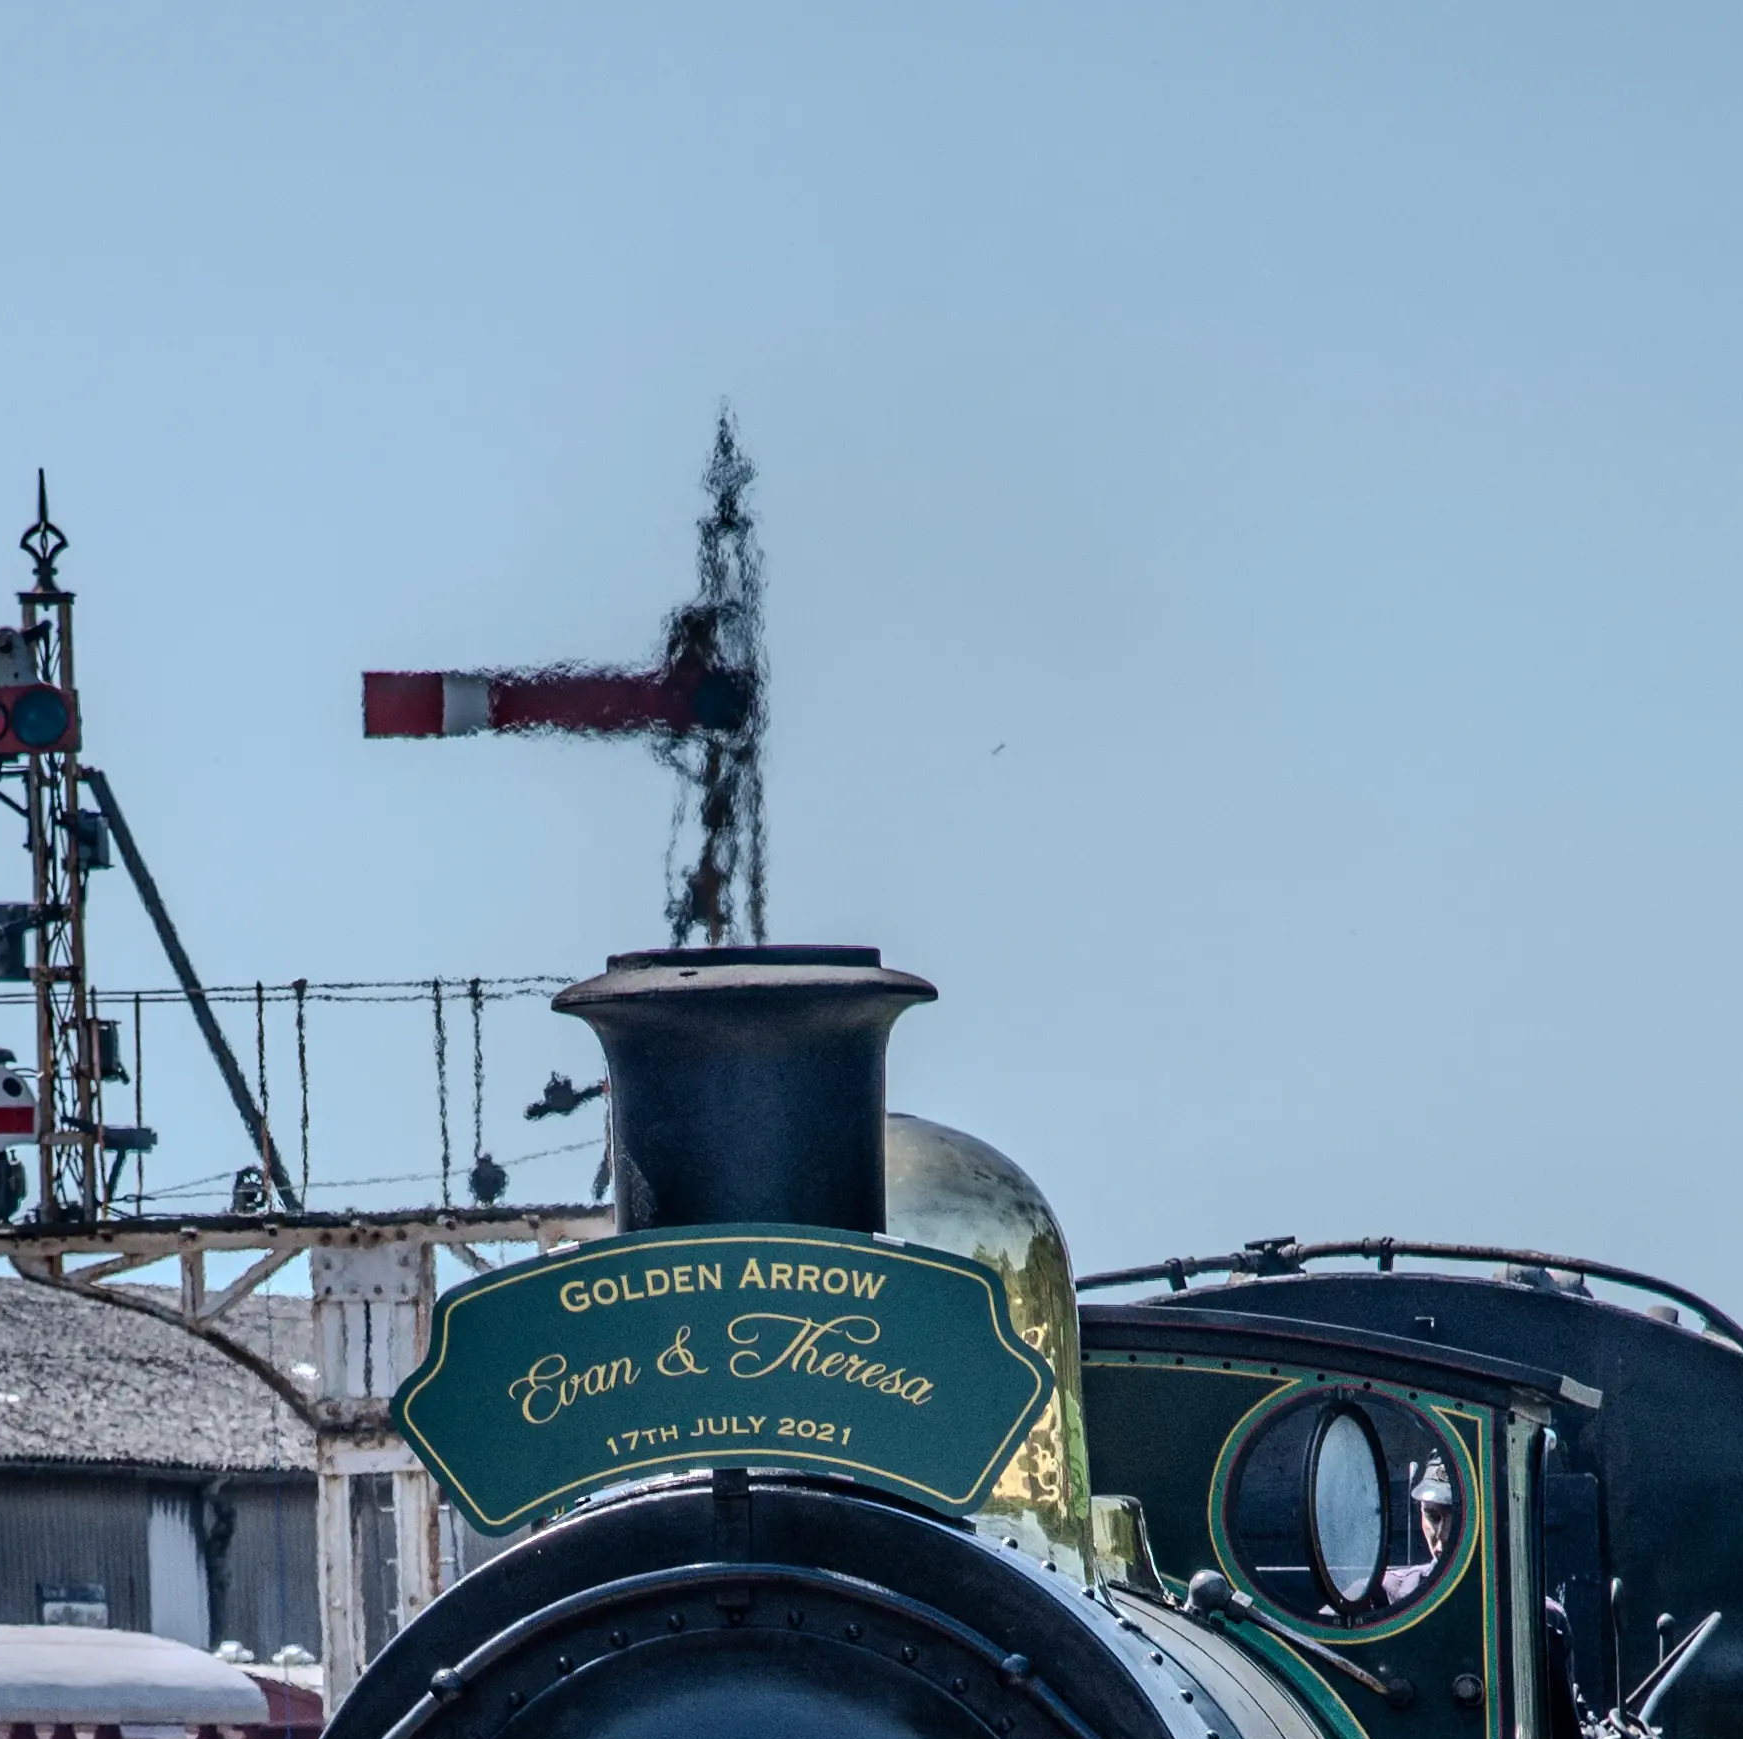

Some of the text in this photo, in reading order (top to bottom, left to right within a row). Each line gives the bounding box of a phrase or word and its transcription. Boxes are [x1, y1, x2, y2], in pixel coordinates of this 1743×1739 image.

[559, 1257, 887, 1313] GOLDEN ARROW
[508, 1312, 938, 1425] Evan & Theresa
[606, 1415, 853, 1456] 17TH JULY 2021
